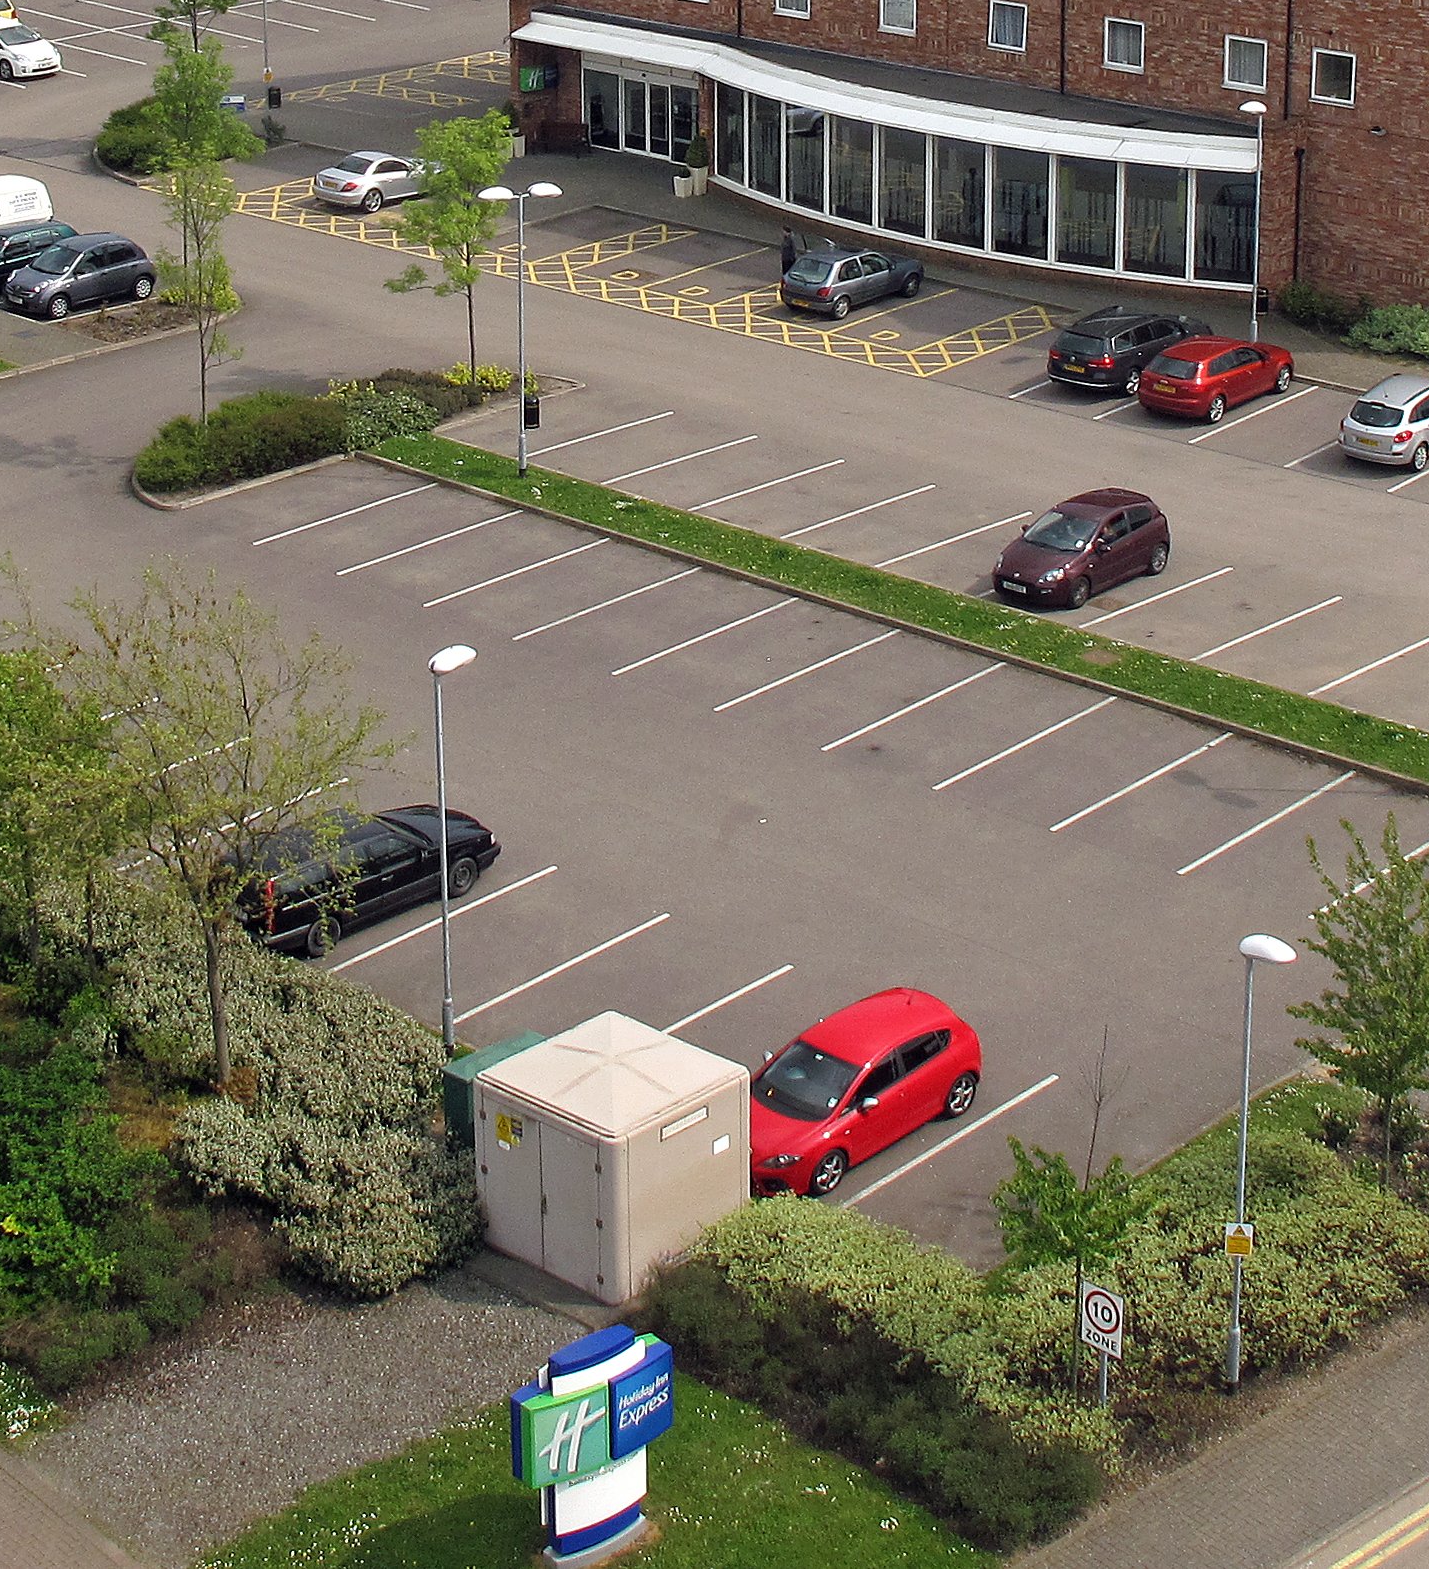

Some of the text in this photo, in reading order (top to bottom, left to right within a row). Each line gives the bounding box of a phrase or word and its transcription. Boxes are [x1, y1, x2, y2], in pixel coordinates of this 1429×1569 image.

[1093, 1302, 1113, 1323] 10
[1086, 1328, 1118, 1352] ZONE
[619, 1382, 655, 1410] Holiday
[619, 1390, 669, 1429] Express
